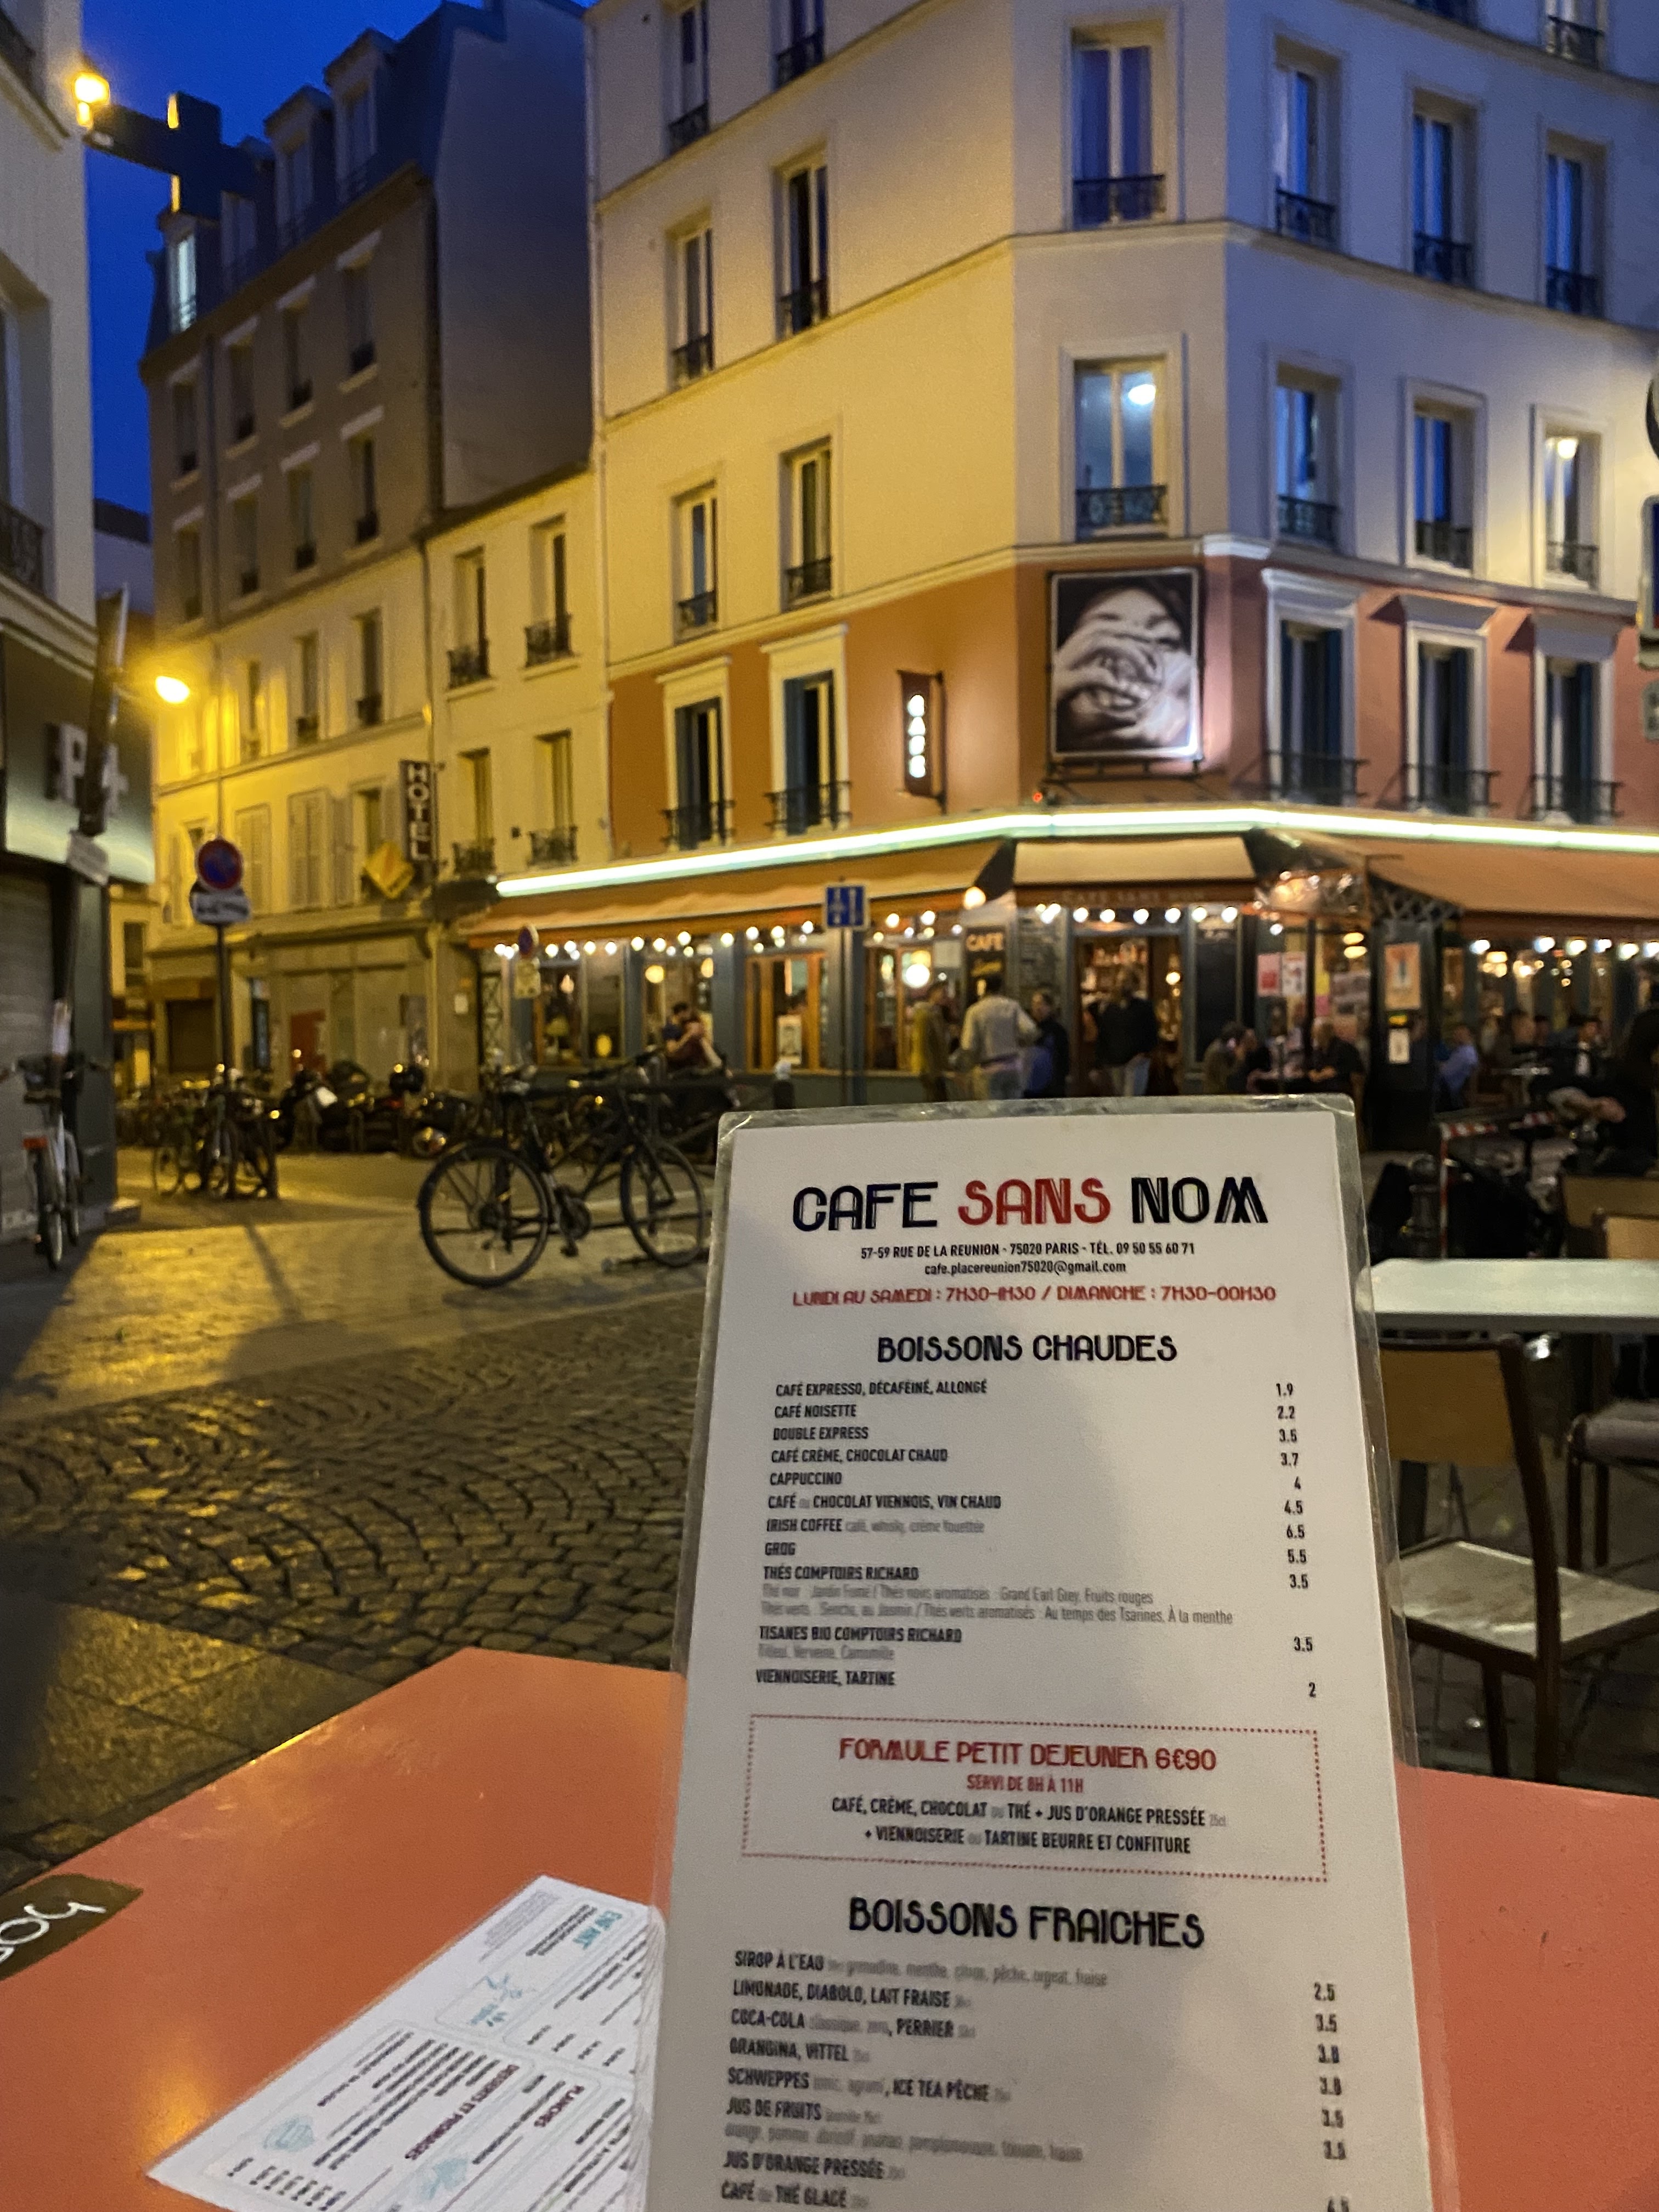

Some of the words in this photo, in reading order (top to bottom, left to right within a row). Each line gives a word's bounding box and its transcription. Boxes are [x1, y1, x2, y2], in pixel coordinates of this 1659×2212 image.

[408, 763, 430, 860] HOTEL
[793, 1181, 938, 1232] CAFE
[958, 1178, 1110, 1226] SANS
[1131, 1177, 1268, 1224] NOM
[861, 1247, 890, 1259] 57-59
[893, 1246, 913, 1258] RUE
[917, 1245, 930, 1257] DE
[934, 1245, 947, 1257] LA
[950, 1244, 999, 1256] REUNION
[1010, 1243, 1042, 1255] 75020
[1045, 1243, 1079, 1255] PARIS
[1090, 1240, 1113, 1255] TÉL.
[1116, 1243, 1128, 1255] 09
[1133, 1243, 1146, 1255] 50
[1149, 1243, 1162, 1254] 55
[1166, 1243, 1178, 1254] 60
[1182, 1242, 1195, 1254] 71
[925, 1261, 1126, 1276] cafe.placereunion75020@gmail.com
[793, 1291, 839, 1306] LUNDI
[843, 1291, 865, 1304] AU
[870, 1289, 932, 1304] SAMEDI
[1042, 1285, 1052, 1301] /
[1057, 1286, 1146, 1301] DIMANCHE
[1161, 1285, 1277, 1301] 7H30-00H30
[878, 1335, 1023, 1363] BOISSONS
[1032, 1334, 1178, 1362] CHAUDES
[776, 1382, 803, 1397] CAFÉ
[806, 1382, 865, 1396] EXPRESSO,
[936, 1379, 988, 1393] ALLONGÉ
[1276, 1383, 1294, 1396] 1.9
[775, 1403, 801, 1418] CAFÉ
[804, 1404, 856, 1418] NOISETTE
[1277, 1406, 1295, 1420] 2.2
[774, 1427, 815, 1441] DOUBLE
[819, 1426, 868, 1440] EXPRESS
[1279, 1429, 1297, 1443] 3.5
[771, 1448, 798, 1463] CAFÉ
[847, 1448, 905, 1462] CHOCOLAT
[909, 1448, 948, 1461] CHAUD
[1280, 1453, 1299, 1466] 3.7
[770, 1472, 842, 1485] CAPPUCCINO
[1294, 1476, 1301, 1490] 4
[768, 1493, 796, 1508] CAFÉ
[813, 1496, 872, 1509] CHOCOLAT
[876, 1496, 934, 1511] VIENNOIS,
[938, 1496, 957, 1509] VIN
[961, 1496, 1001, 1509] CHAUD
[1284, 1500, 1303, 1515] 4.5
[766, 1519, 797, 1532] IRISH
[801, 1519, 842, 1532] COFFEE
[1286, 1525, 1305, 1538] 6.5
[765, 1542, 795, 1556] GROG
[1288, 1549, 1307, 1564] 5.5
[764, 1564, 792, 1579] THÉS
[795, 1566, 862, 1580] COMPTOIRS
[866, 1566, 919, 1581] RICHARD
[1289, 1574, 1308, 1589] 3.5
[760, 1626, 808, 1640] TISANES
[812, 1627, 831, 1640] BIO
[834, 1627, 904, 1641] COMPTOIRS
[907, 1628, 962, 1643] RICHARD
[1294, 1637, 1313, 1652] 3.5
[757, 1669, 842, 1686] VIENNOISERIE,
[846, 1671, 895, 1685] TARTINE
[1308, 1682, 1316, 1697] 2
[839, 1737, 950, 1763] FORMULE
[956, 1741, 1023, 1765] PETIT
[1030, 1743, 1148, 1769] DEJEUNER
[1155, 1747, 1216, 1771] 6€90
[967, 1774, 1004, 1790] SERVI
[1008, 1775, 1023, 1791] DE
[1060, 1778, 1084, 1793] 11H
[832, 1795, 867, 1814] CAFÉ,
[870, 1796, 917, 1816] CRÈME,
[921, 1799, 988, 1818] CHOCOLAT
[1008, 1799, 1031, 1819] THÉ
[1047, 1805, 1071, 1821] JUS
[1076, 1805, 1142, 1824] D'ORANGE
[1147, 1806, 1206, 1827] PRESSÉE
[875, 1825, 964, 1844] VIENNOISERIE
[985, 1829, 1037, 1847] TARTINE
[1042, 1831, 1093, 1850] BEURRE
[1098, 1833, 1111, 1850] ET
[1116, 1835, 1191, 1854] CONFITURE
[849, 1896, 1017, 1938] BOISSONS
[1029, 1905, 1204, 1948] FRAICHES
[735, 1950, 772, 1968] SIROP
[733, 1979, 803, 2001] LIMONADE,
[807, 1983, 867, 2005] DIABOLO,
[871, 1987, 899, 2004] LAIT
[904, 1989, 951, 2008] FRAISE
[1314, 1982, 1335, 2001] 2.5
[731, 2008, 805, 2029] COCA-COLA
[896, 2017, 955, 2038] PERRIER
[806, 2042, 849, 2062] VITTEL
[728, 2066, 809, 2089] SCHWEPPES
[893, 2078, 913, 2096] ICE
[918, 2079, 943, 2098] TEA
[727, 2097, 752, 2115] JUS
[755, 2098, 771, 2118] DE
[775, 2101, 822, 2121] FRUITS
[724, 2151, 749, 2169] JUS
[824, 2157, 885, 2180] PRESSÉE
